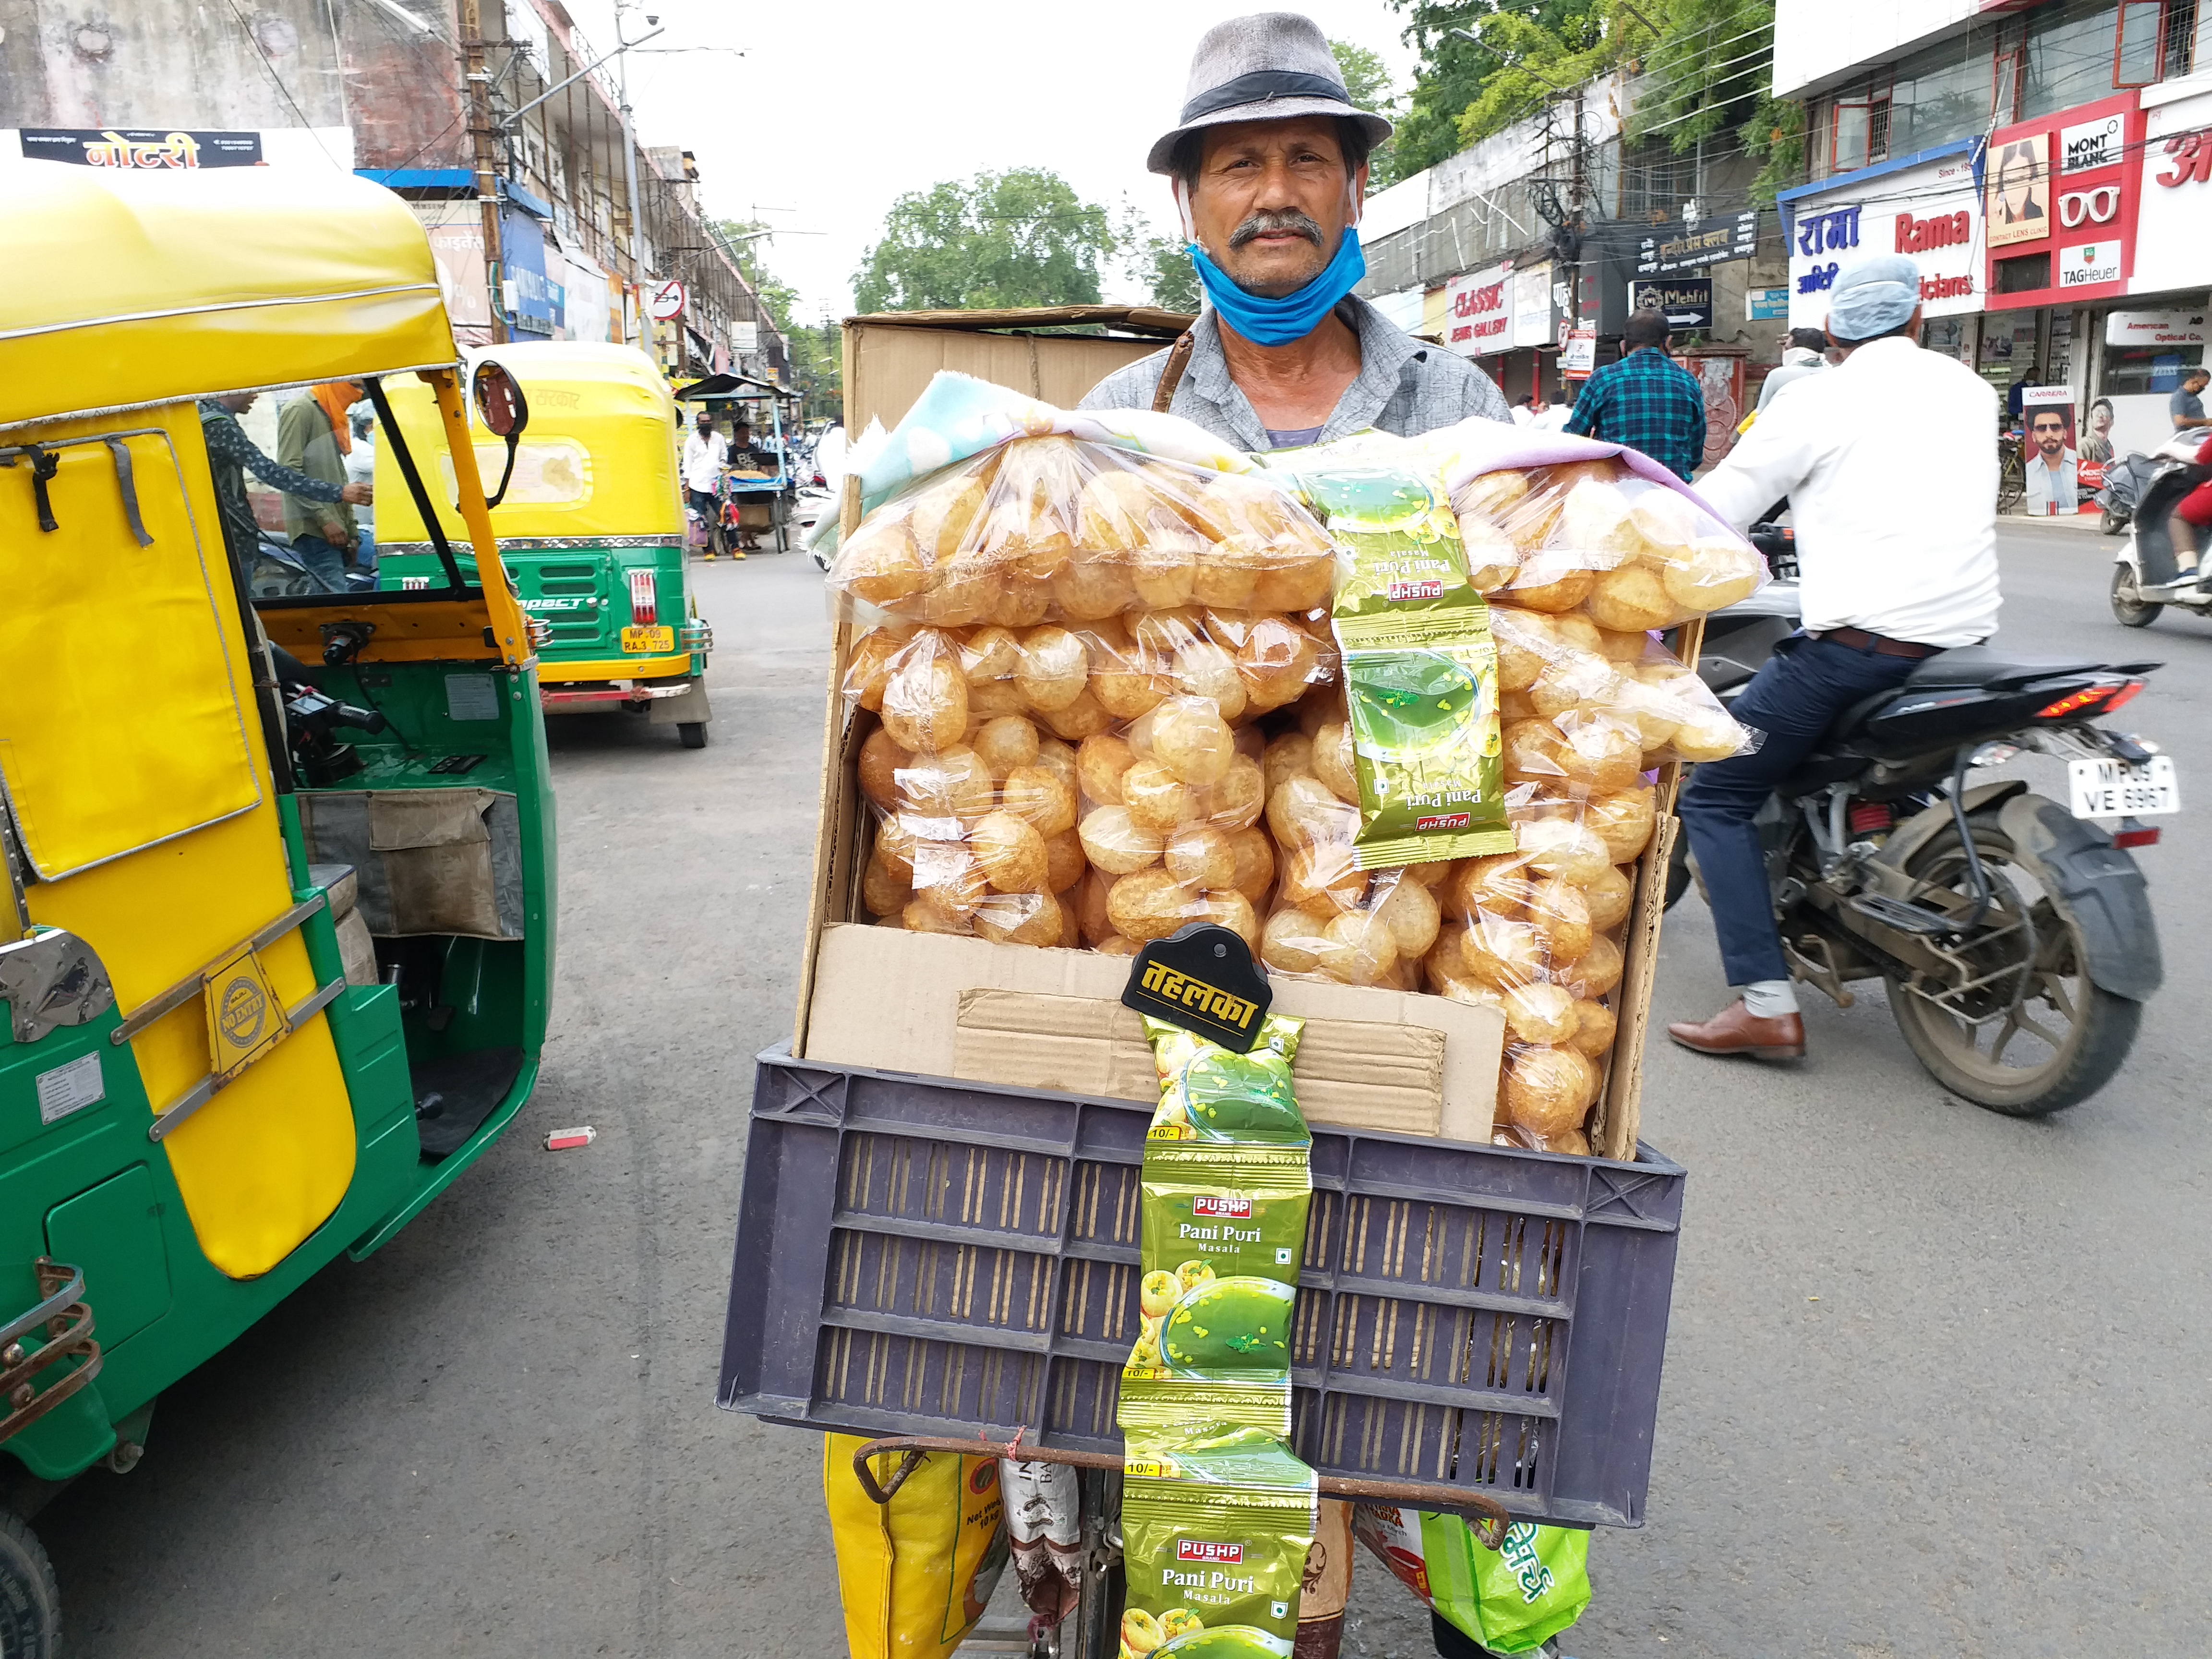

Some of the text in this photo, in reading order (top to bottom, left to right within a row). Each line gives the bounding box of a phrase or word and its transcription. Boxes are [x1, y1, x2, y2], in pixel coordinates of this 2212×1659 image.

[83, 131, 201, 168] नोटरी
[2068, 133, 2108, 156] MONT
[1939, 168, 1955, 179] Since
[1798, 204, 1862, 256] रामा
[1895, 210, 1970, 253] Rama
[1989, 233, 2011, 242] CONTACT
[2013, 228, 2028, 238] LENS
[1919, 273, 1973, 301] icians
[1455, 281, 1503, 318] CLASSIC
[1664, 289, 1708, 304] Mehfil
[1474, 317, 1508, 337] GALLERY
[2155, 333, 2203, 342] Optical Co.
[1373, 559, 1451, 576] Pani Puri
[1392, 583, 1441, 599] PUSHP
[521, 598, 584, 610] pact
[629, 630, 644, 639] MP
[653, 640, 671, 650] 725
[1423, 780, 1461, 789] Masala
[1407, 789, 1482, 810] Pani Puri
[2083, 789, 2117, 812] VE
[1418, 817, 1467, 830] PUSHP
[1141, 960, 1259, 1029] तहलका
[222, 994, 263, 1033] NO ENTRY
[1151, 1130, 1174, 1138] 10/-
[1196, 1199, 1249, 1213] PUSHP
[1179, 1223, 1262, 1243] Pani Puri
[1198, 1243, 1240, 1253] Masala
[1127, 1369, 1149, 1377] 10/-
[1128, 1463, 1154, 1474] 10/-
[980, 1515, 989, 1530] 10
[1181, 1544, 1239, 1558] PUSHP
[1162, 1569, 1254, 1594] Pani Puri
[1183, 1589, 1231, 1605] Masala
